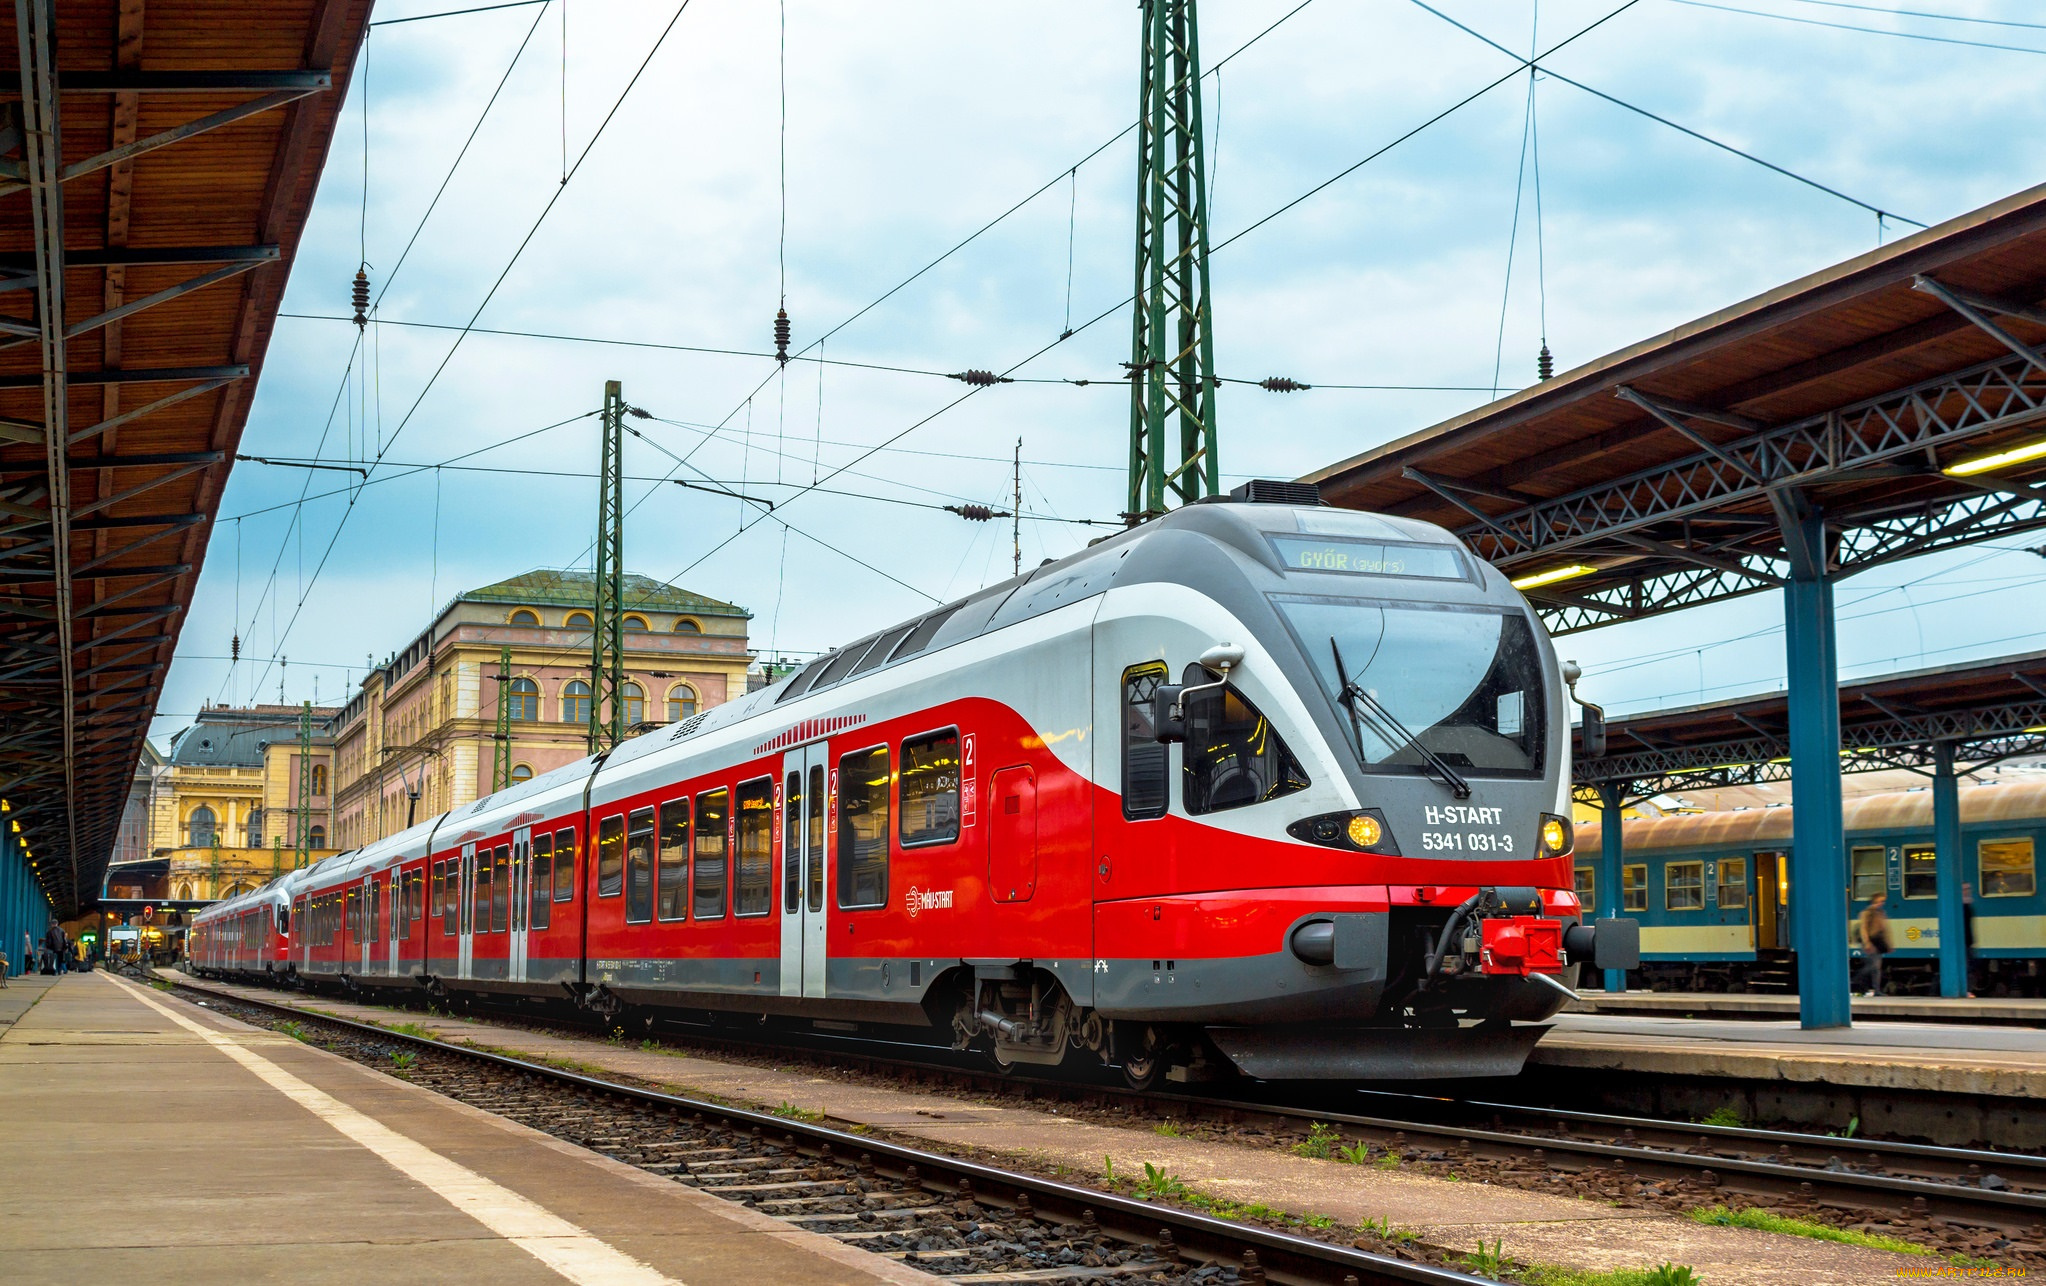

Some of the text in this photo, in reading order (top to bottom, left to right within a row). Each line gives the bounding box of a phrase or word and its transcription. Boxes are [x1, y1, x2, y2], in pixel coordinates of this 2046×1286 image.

[1301, 548, 1348, 569] GYŐR
[965, 738, 973, 766] 2
[832, 772, 837, 796] 2
[775, 786, 781, 808] 2
[1424, 805, 1502, 825] H-START
[1422, 832, 1514, 852] 5341 031-3
[1889, 849, 1898, 861] 2
[1707, 863, 1714, 875] 2
